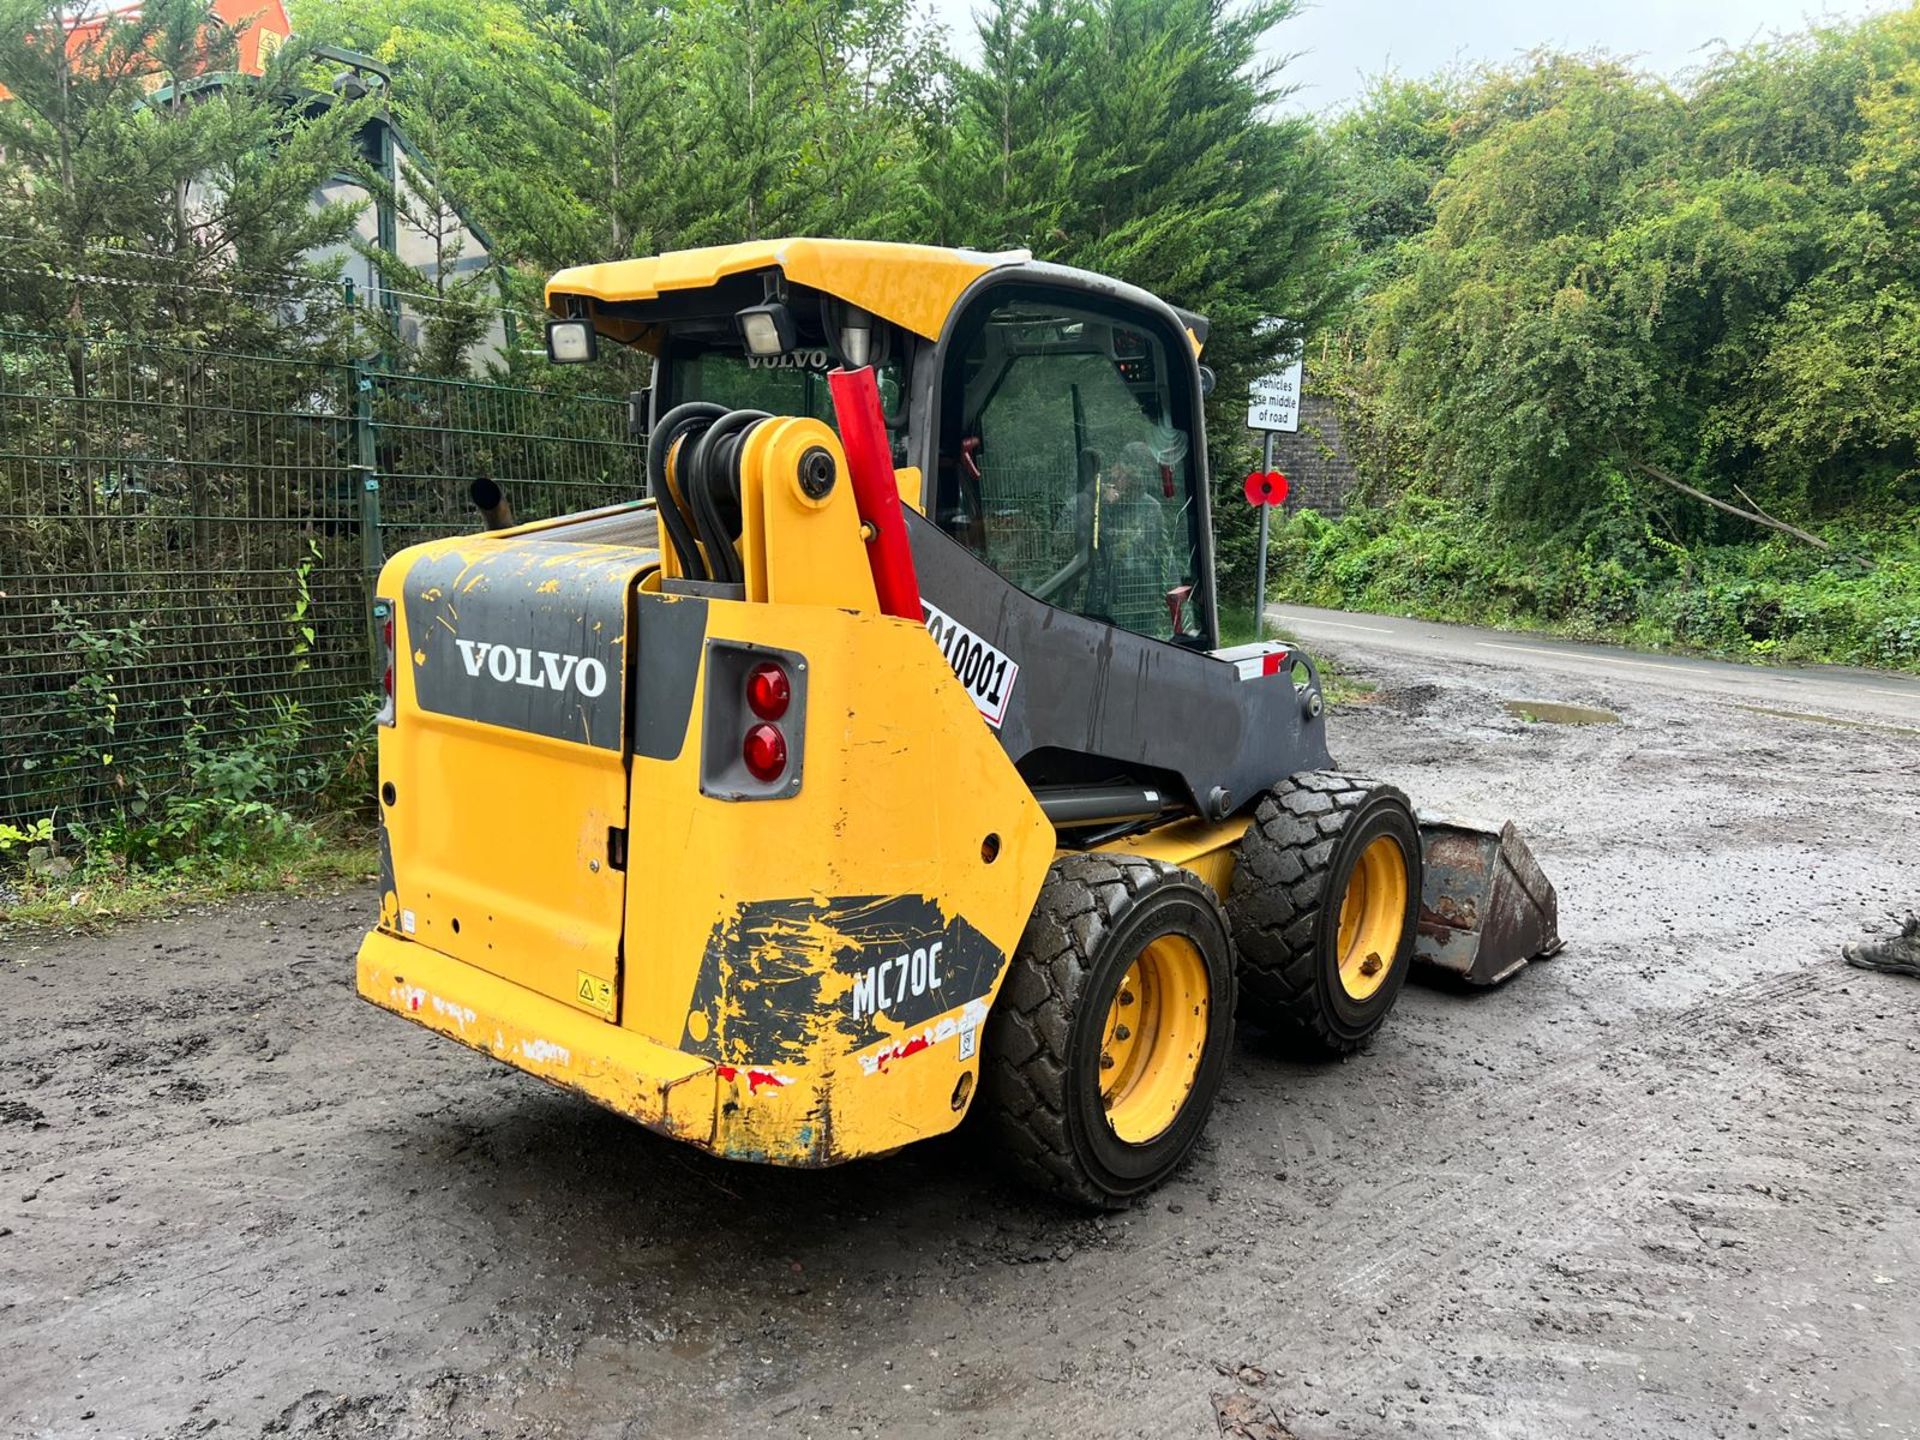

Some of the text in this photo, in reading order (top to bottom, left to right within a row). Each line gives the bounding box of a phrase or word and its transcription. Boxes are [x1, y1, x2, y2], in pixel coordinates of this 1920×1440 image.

[747, 350, 827, 369] VOLVO
[1269, 394, 1296, 408] middle
[1259, 409, 1288, 424] of road
[455, 638, 607, 698] VOLVO
[853, 941, 943, 1021] MC70C
